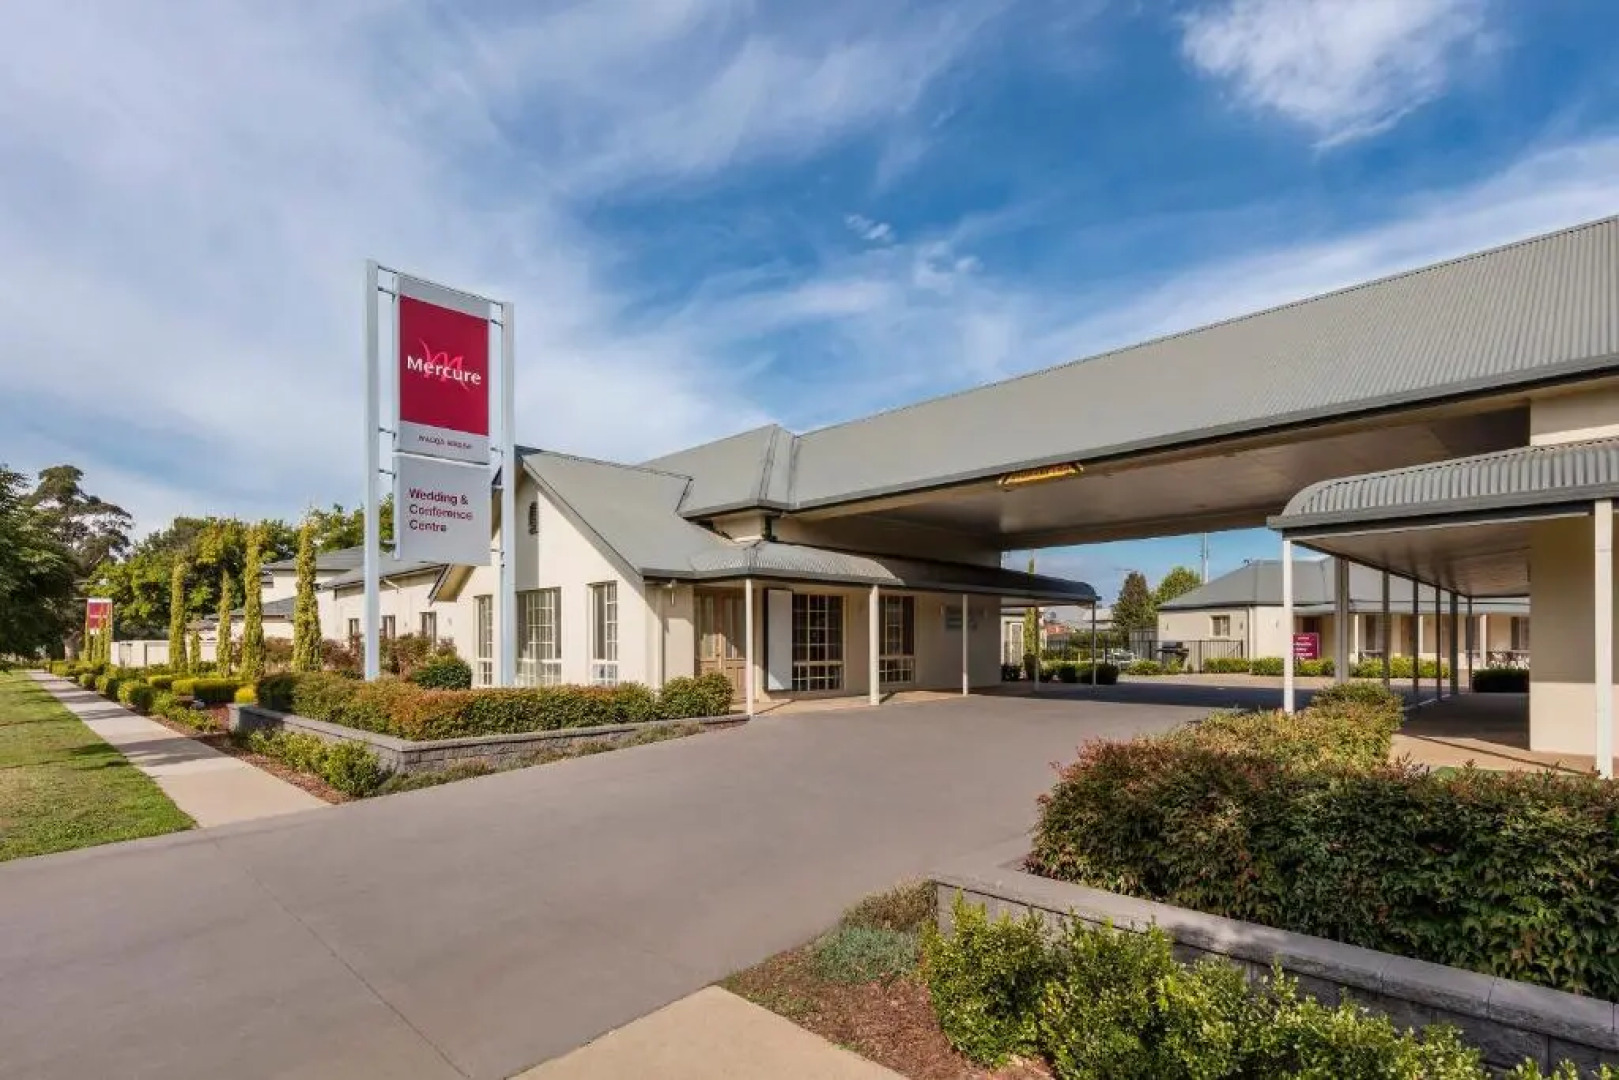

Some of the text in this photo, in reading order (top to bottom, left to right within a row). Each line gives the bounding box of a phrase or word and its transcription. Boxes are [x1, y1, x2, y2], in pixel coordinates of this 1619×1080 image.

[407, 355, 481, 385] Mercure
[409, 487, 469, 506] Wedding &
[409, 504, 473, 520] Conference
[409, 519, 447, 532] Centre
